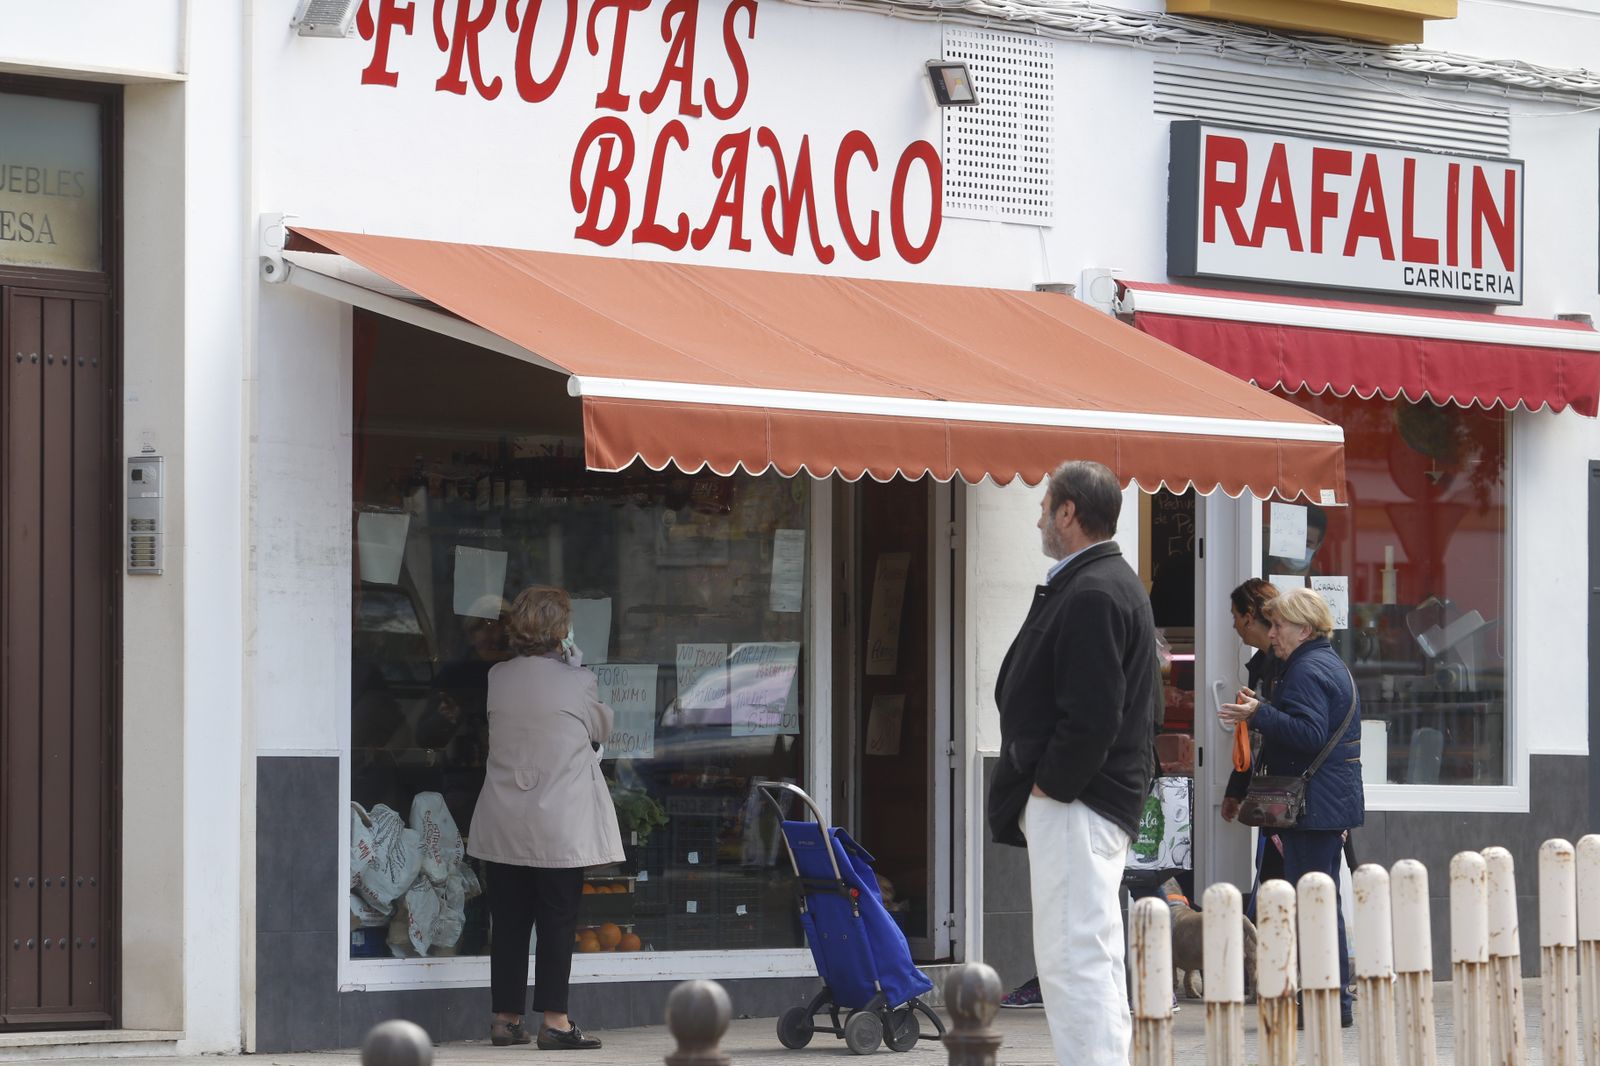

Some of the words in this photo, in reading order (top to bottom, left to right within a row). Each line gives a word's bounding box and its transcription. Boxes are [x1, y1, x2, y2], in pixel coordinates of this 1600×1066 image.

[355, 0, 758, 120] FRUTAS
[570, 116, 942, 264] BLANCO
[1203, 134, 1516, 272] RAFALIN
[1404, 267, 1515, 294] CARNICERIA
